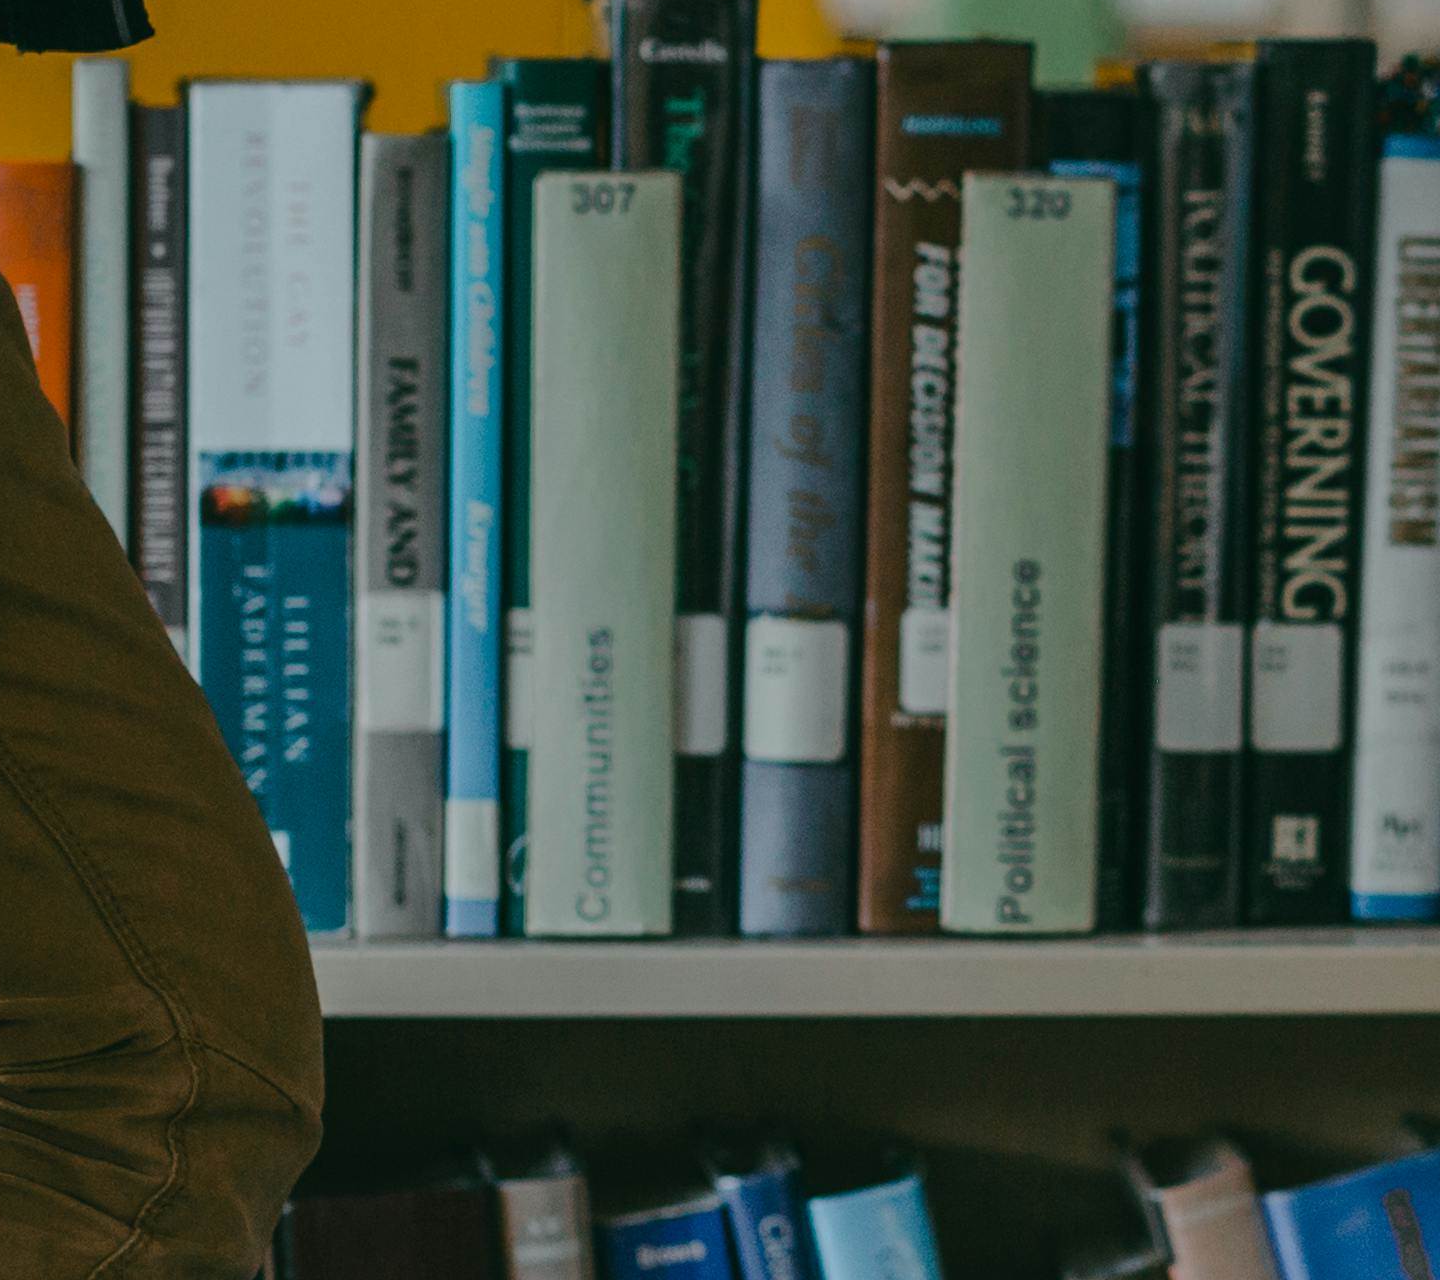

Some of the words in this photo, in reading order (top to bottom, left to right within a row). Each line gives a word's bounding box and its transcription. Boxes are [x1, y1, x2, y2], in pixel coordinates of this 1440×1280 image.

[571, 184, 634, 217] 307
[1006, 190, 1070, 221] 320
[915, 242, 950, 315] FOR
[387, 356, 419, 490] FAMILY
[1283, 247, 1354, 623] GOVERNING
[387, 498, 419, 592] AND
[1009, 560, 1041, 726] science
[573, 625, 619, 922] Communities
[999, 734, 1042, 926] Political
